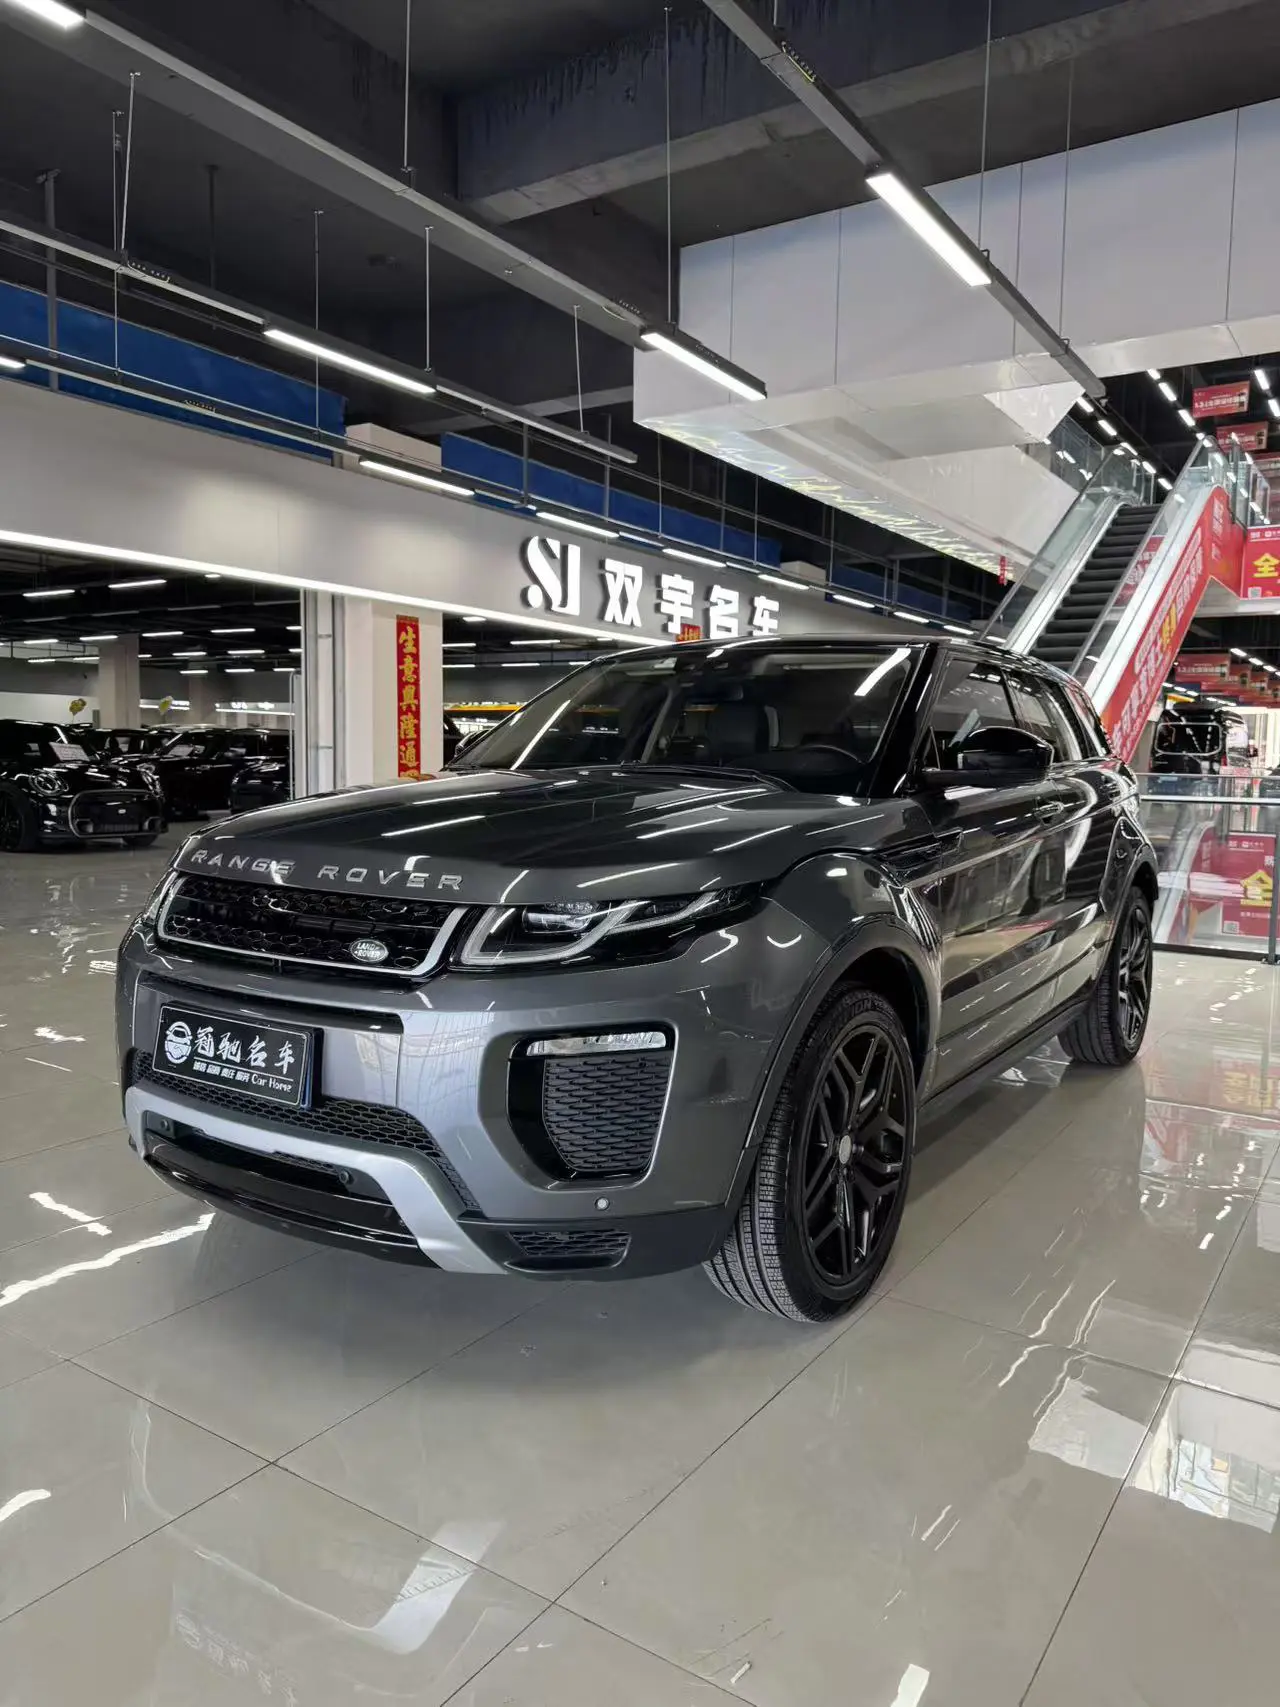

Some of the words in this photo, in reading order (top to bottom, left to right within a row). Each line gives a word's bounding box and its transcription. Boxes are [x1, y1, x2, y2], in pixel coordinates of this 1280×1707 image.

[604, 558, 780, 639] 双宇名车
[190, 849, 296, 875] RANGE
[316, 865, 464, 890] ROVER
[357, 942, 376, 950] LAND
[357, 950, 382, 958] ROVER
[251, 1074, 268, 1087] Car
[269, 1077, 293, 1093] Home
